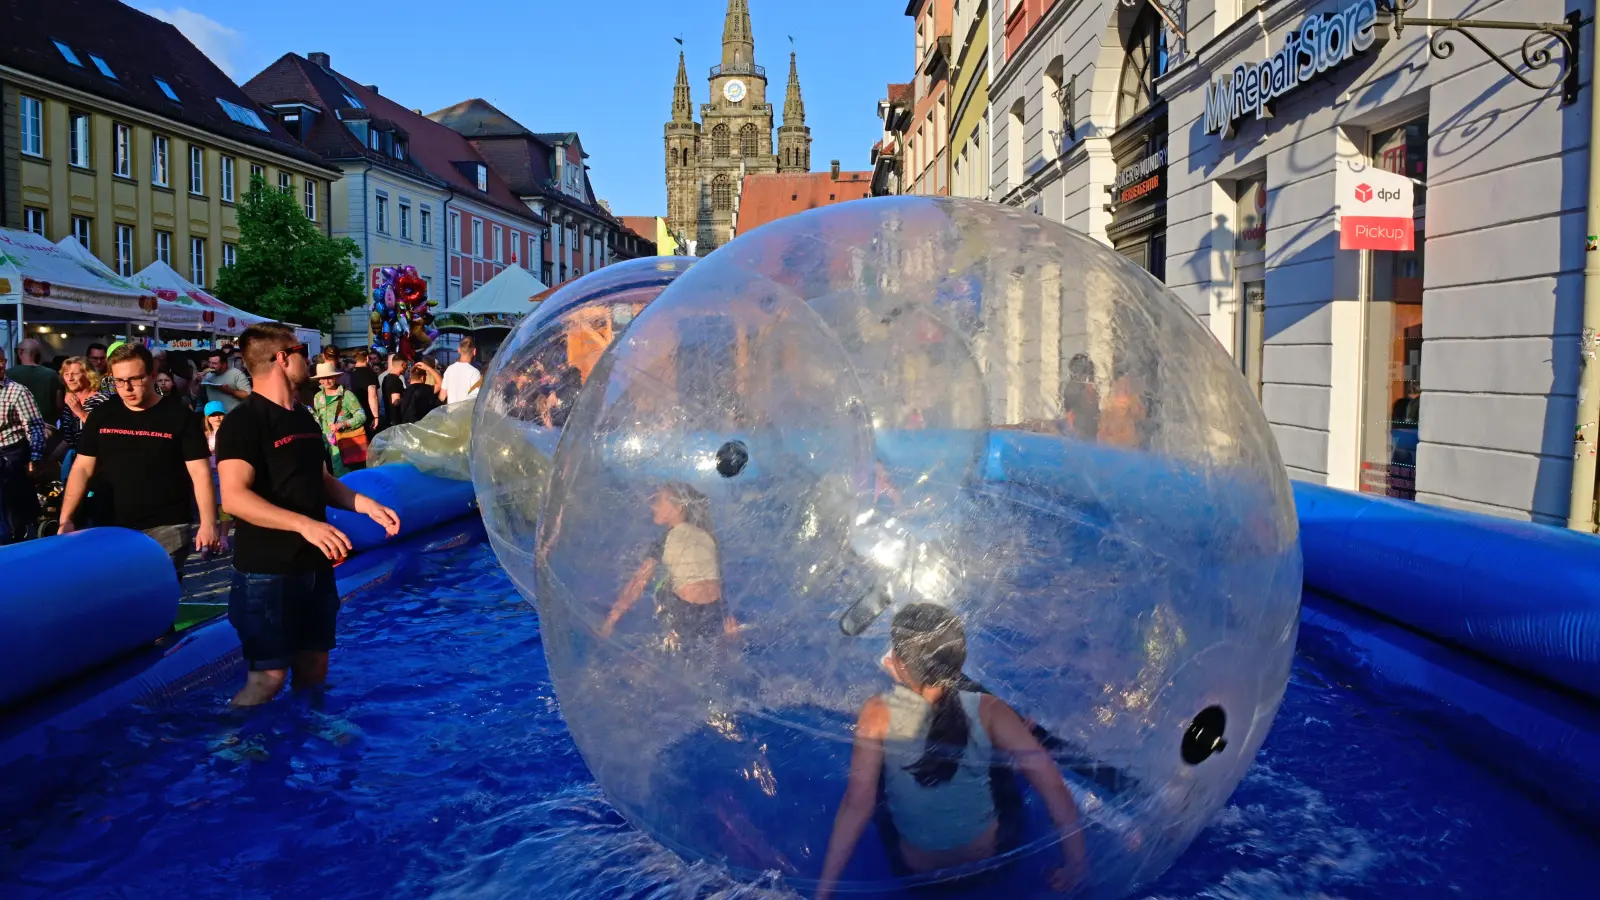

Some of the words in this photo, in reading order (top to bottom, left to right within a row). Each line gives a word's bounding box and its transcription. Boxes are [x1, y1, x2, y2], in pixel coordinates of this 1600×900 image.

[1204, 0, 1377, 140] MyRepairStore
[1377, 188, 1401, 202] dpd
[1355, 224, 1404, 241] Pickup
